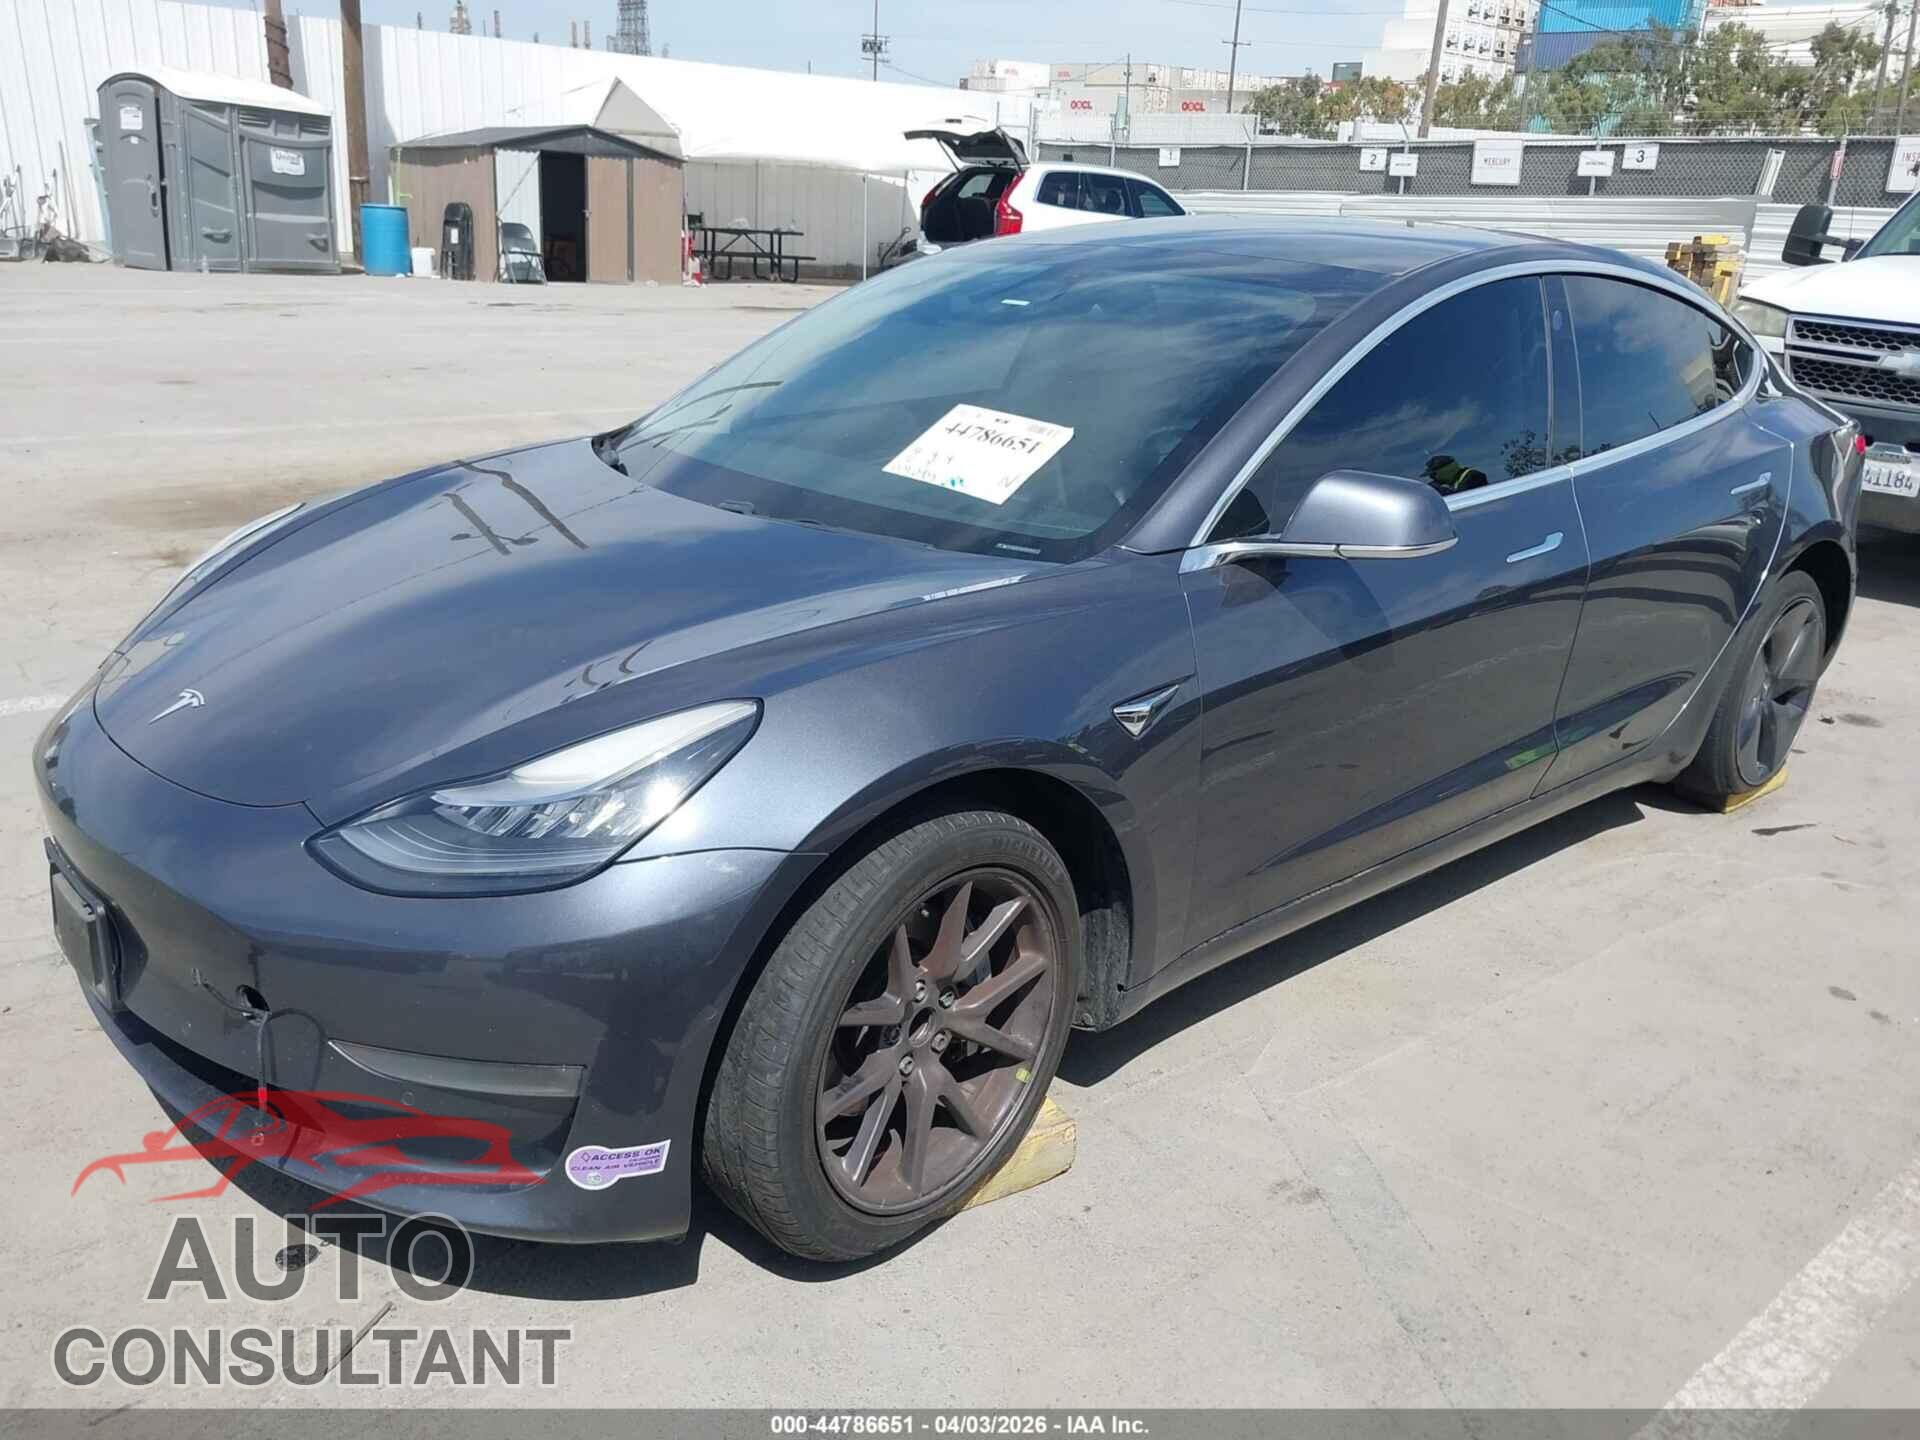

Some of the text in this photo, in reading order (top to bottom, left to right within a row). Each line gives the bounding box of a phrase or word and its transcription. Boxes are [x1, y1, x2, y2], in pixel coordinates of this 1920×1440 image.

[1369, 153, 1377, 165] 2
[1636, 149, 1646, 163] 3
[945, 422, 1042, 454] 44786651
[591, 1151, 641, 1161] ACCESS
[645, 1148, 660, 1157] OK
